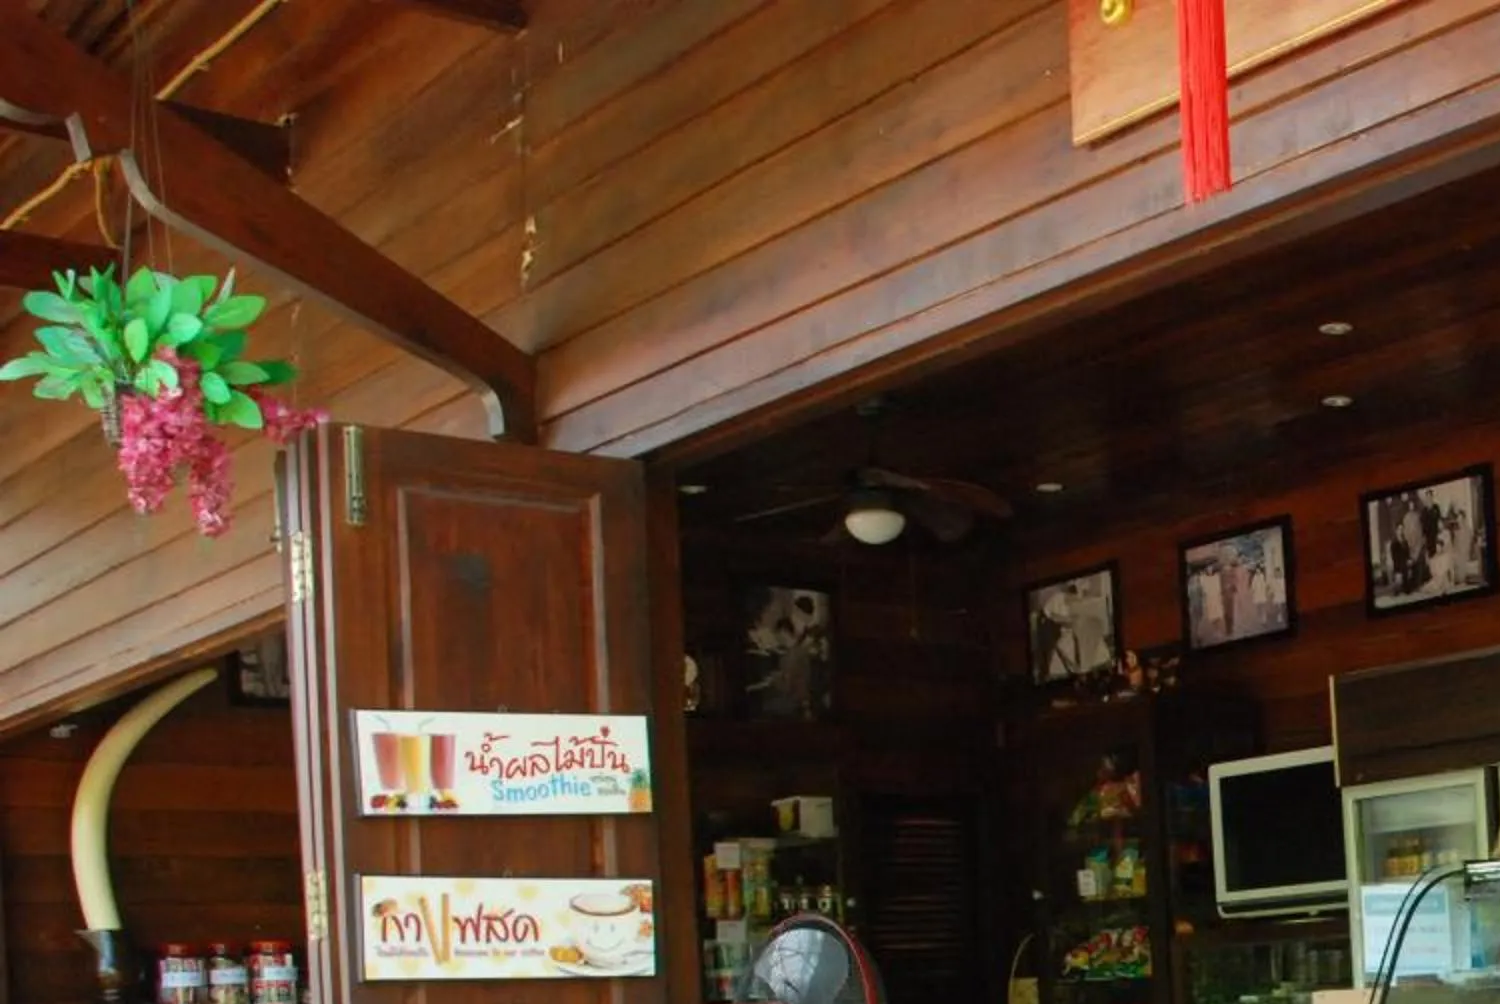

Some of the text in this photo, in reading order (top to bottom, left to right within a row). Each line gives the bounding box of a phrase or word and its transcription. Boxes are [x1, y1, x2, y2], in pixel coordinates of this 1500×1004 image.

[464, 726, 631, 779] น้ำผลไม้ปั่น
[491, 773, 592, 802] Smoothie
